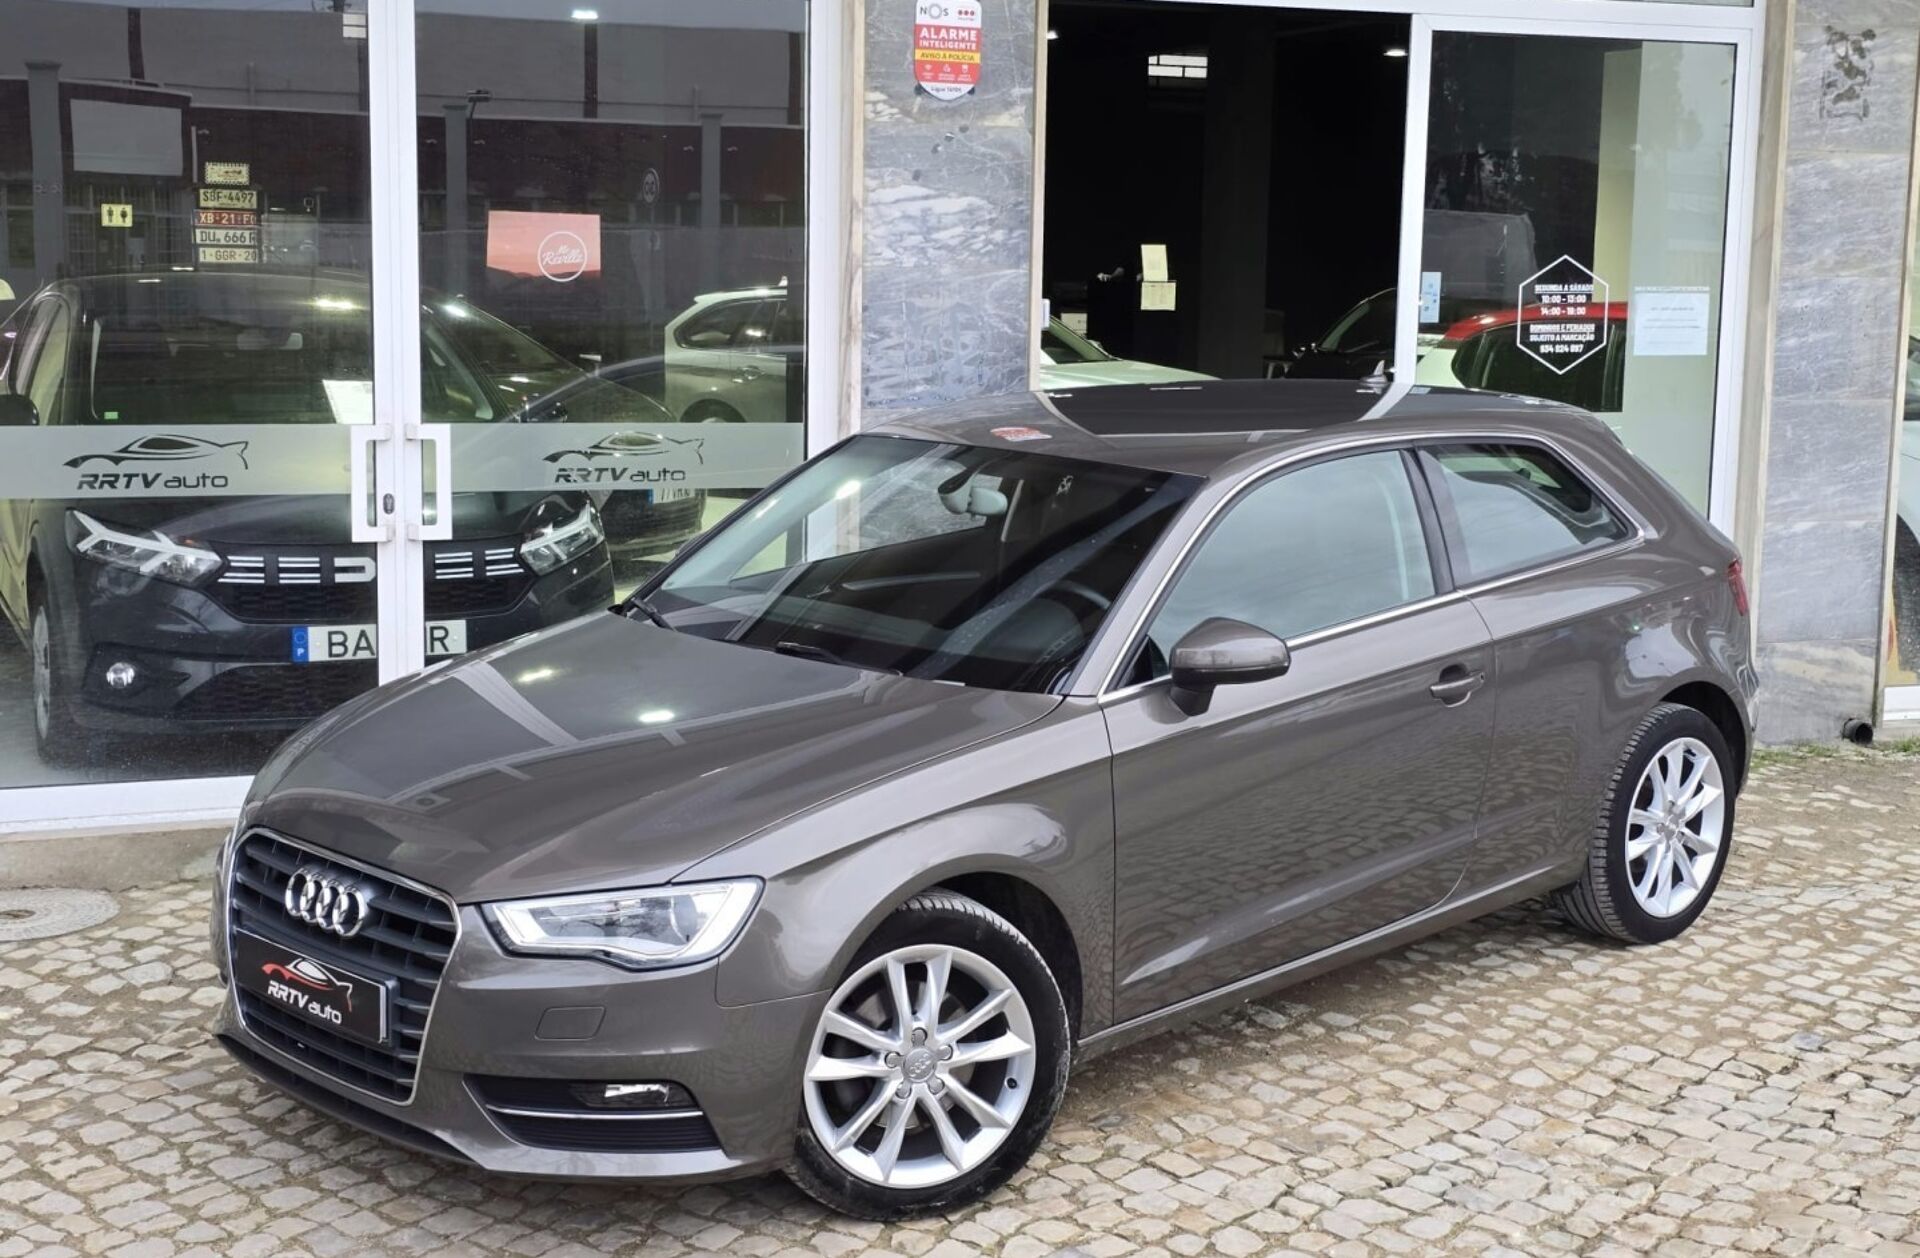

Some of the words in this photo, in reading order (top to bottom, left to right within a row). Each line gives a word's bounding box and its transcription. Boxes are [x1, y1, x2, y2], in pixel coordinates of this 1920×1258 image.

[920, 4, 949, 19] NOS
[920, 27, 977, 42] ALARME
[919, 39, 977, 51] INTELIGENTE
[1563, 283, 1569, 292] A
[77, 472, 163, 490] RRTV
[163, 472, 229, 489] auto
[554, 467, 629, 484] RRTV
[629, 467, 686, 483] auto
[267, 979, 309, 1009] RRTV
[307, 1000, 343, 1024] auto
